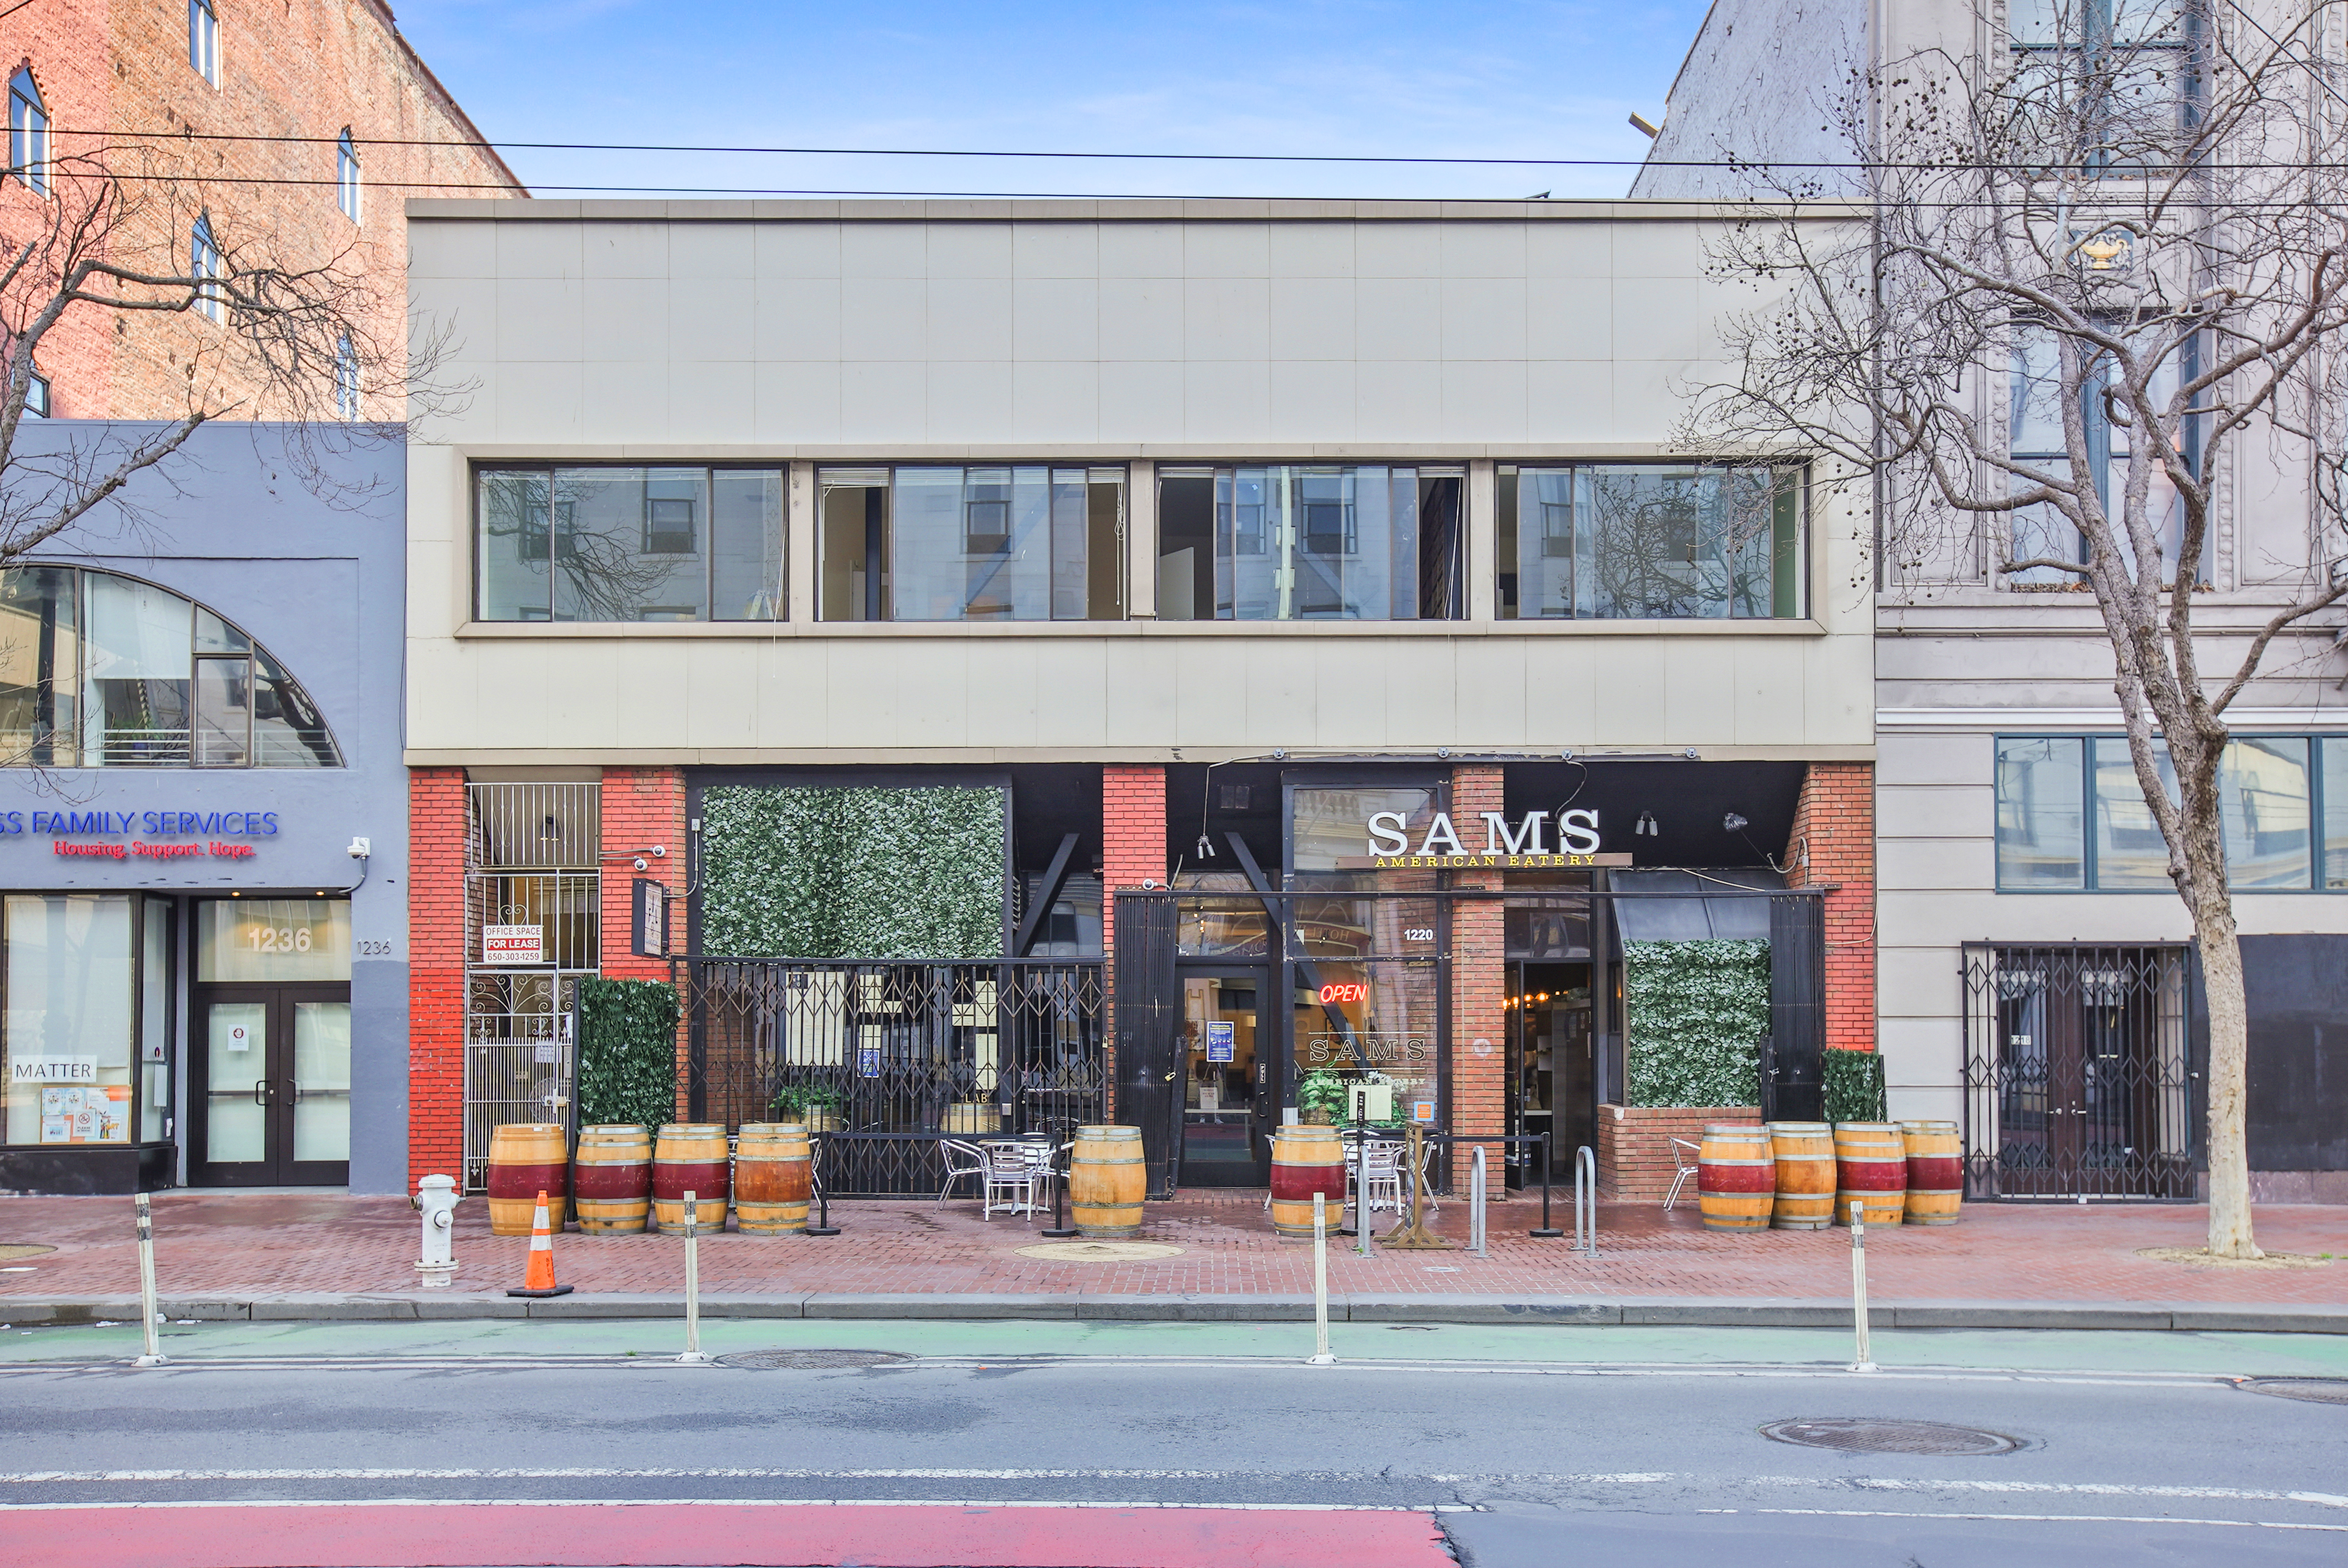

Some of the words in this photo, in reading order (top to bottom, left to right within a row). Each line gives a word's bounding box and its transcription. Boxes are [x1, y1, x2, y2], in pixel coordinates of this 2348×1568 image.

[32, 811, 136, 834] FAMILY
[143, 811, 278, 834] SERVICES
[1368, 809, 1601, 857] SAMS
[131, 841, 205, 859] Support.
[209, 841, 256, 859] Hope.
[1375, 856, 1496, 868] AMERICAN
[1508, 854, 1596, 866] EATERY
[516, 927, 540, 935] SPACE
[1404, 929, 1434, 941] 1220
[249, 927, 311, 952] 1236
[488, 940, 507, 948] FOR
[509, 939, 539, 948] LEASE
[357, 941, 391, 955] 1236
[488, 952, 539, 961] 650-303-1259
[1320, 984, 1368, 1003] OPEN
[1310, 1039, 1425, 1061] SAMS
[16, 1064, 90, 1077] MATTER
